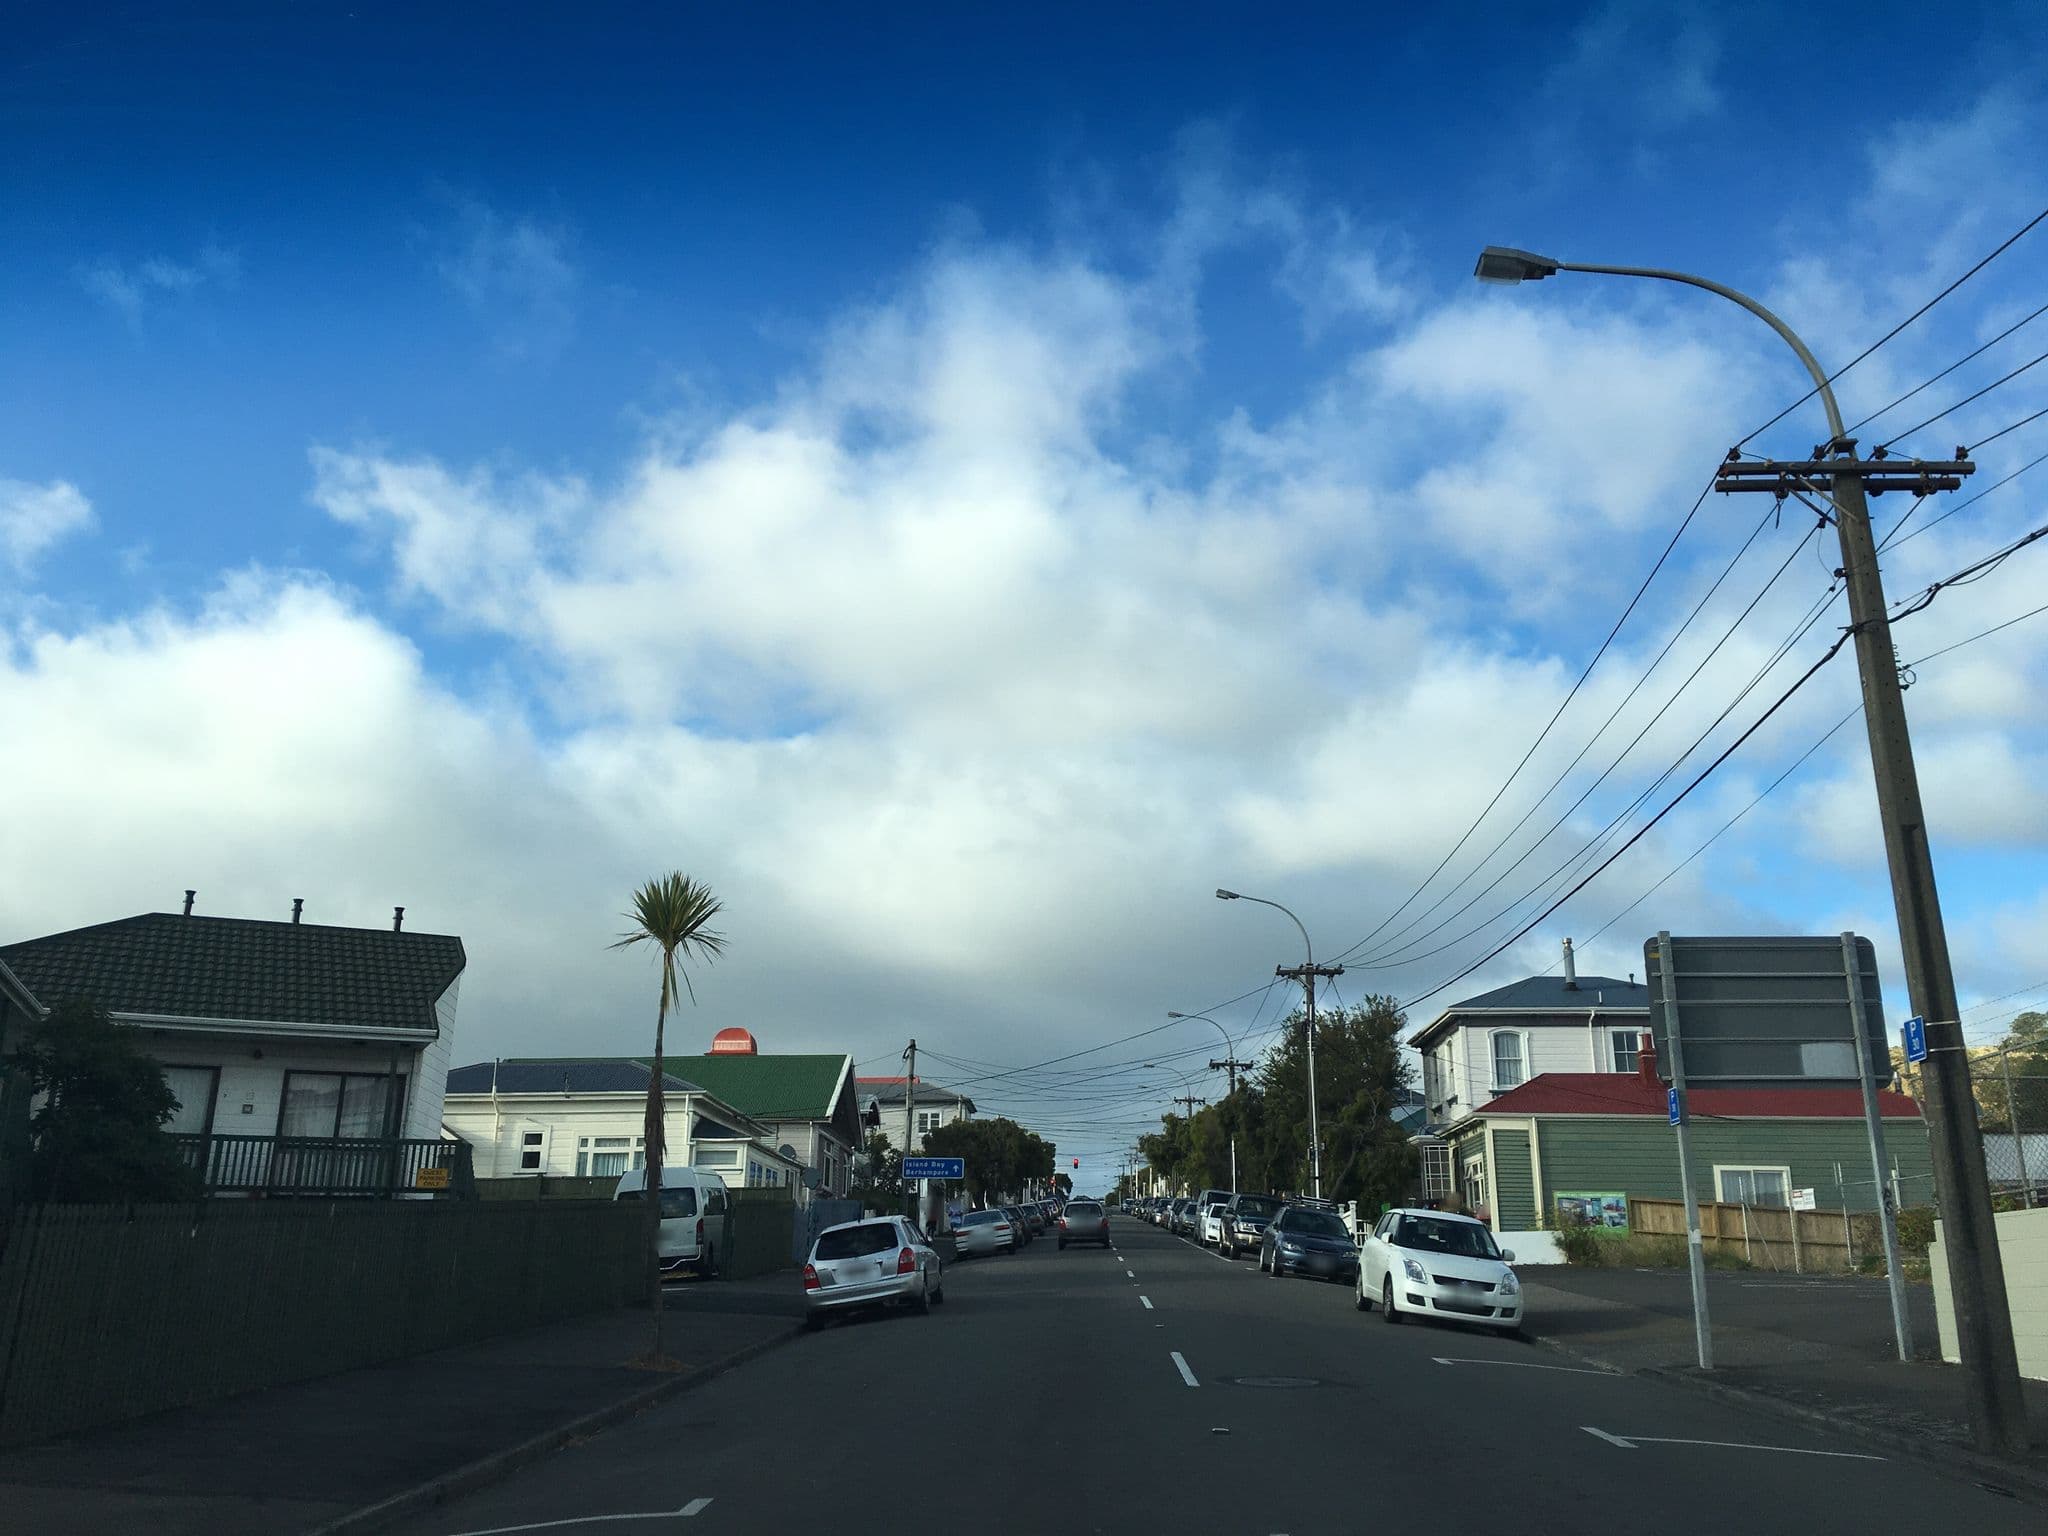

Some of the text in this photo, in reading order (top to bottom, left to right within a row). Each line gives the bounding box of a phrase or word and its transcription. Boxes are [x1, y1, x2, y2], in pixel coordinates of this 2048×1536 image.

[1910, 1021, 1917, 1038] P
[905, 1160, 946, 1169] Island Bay
